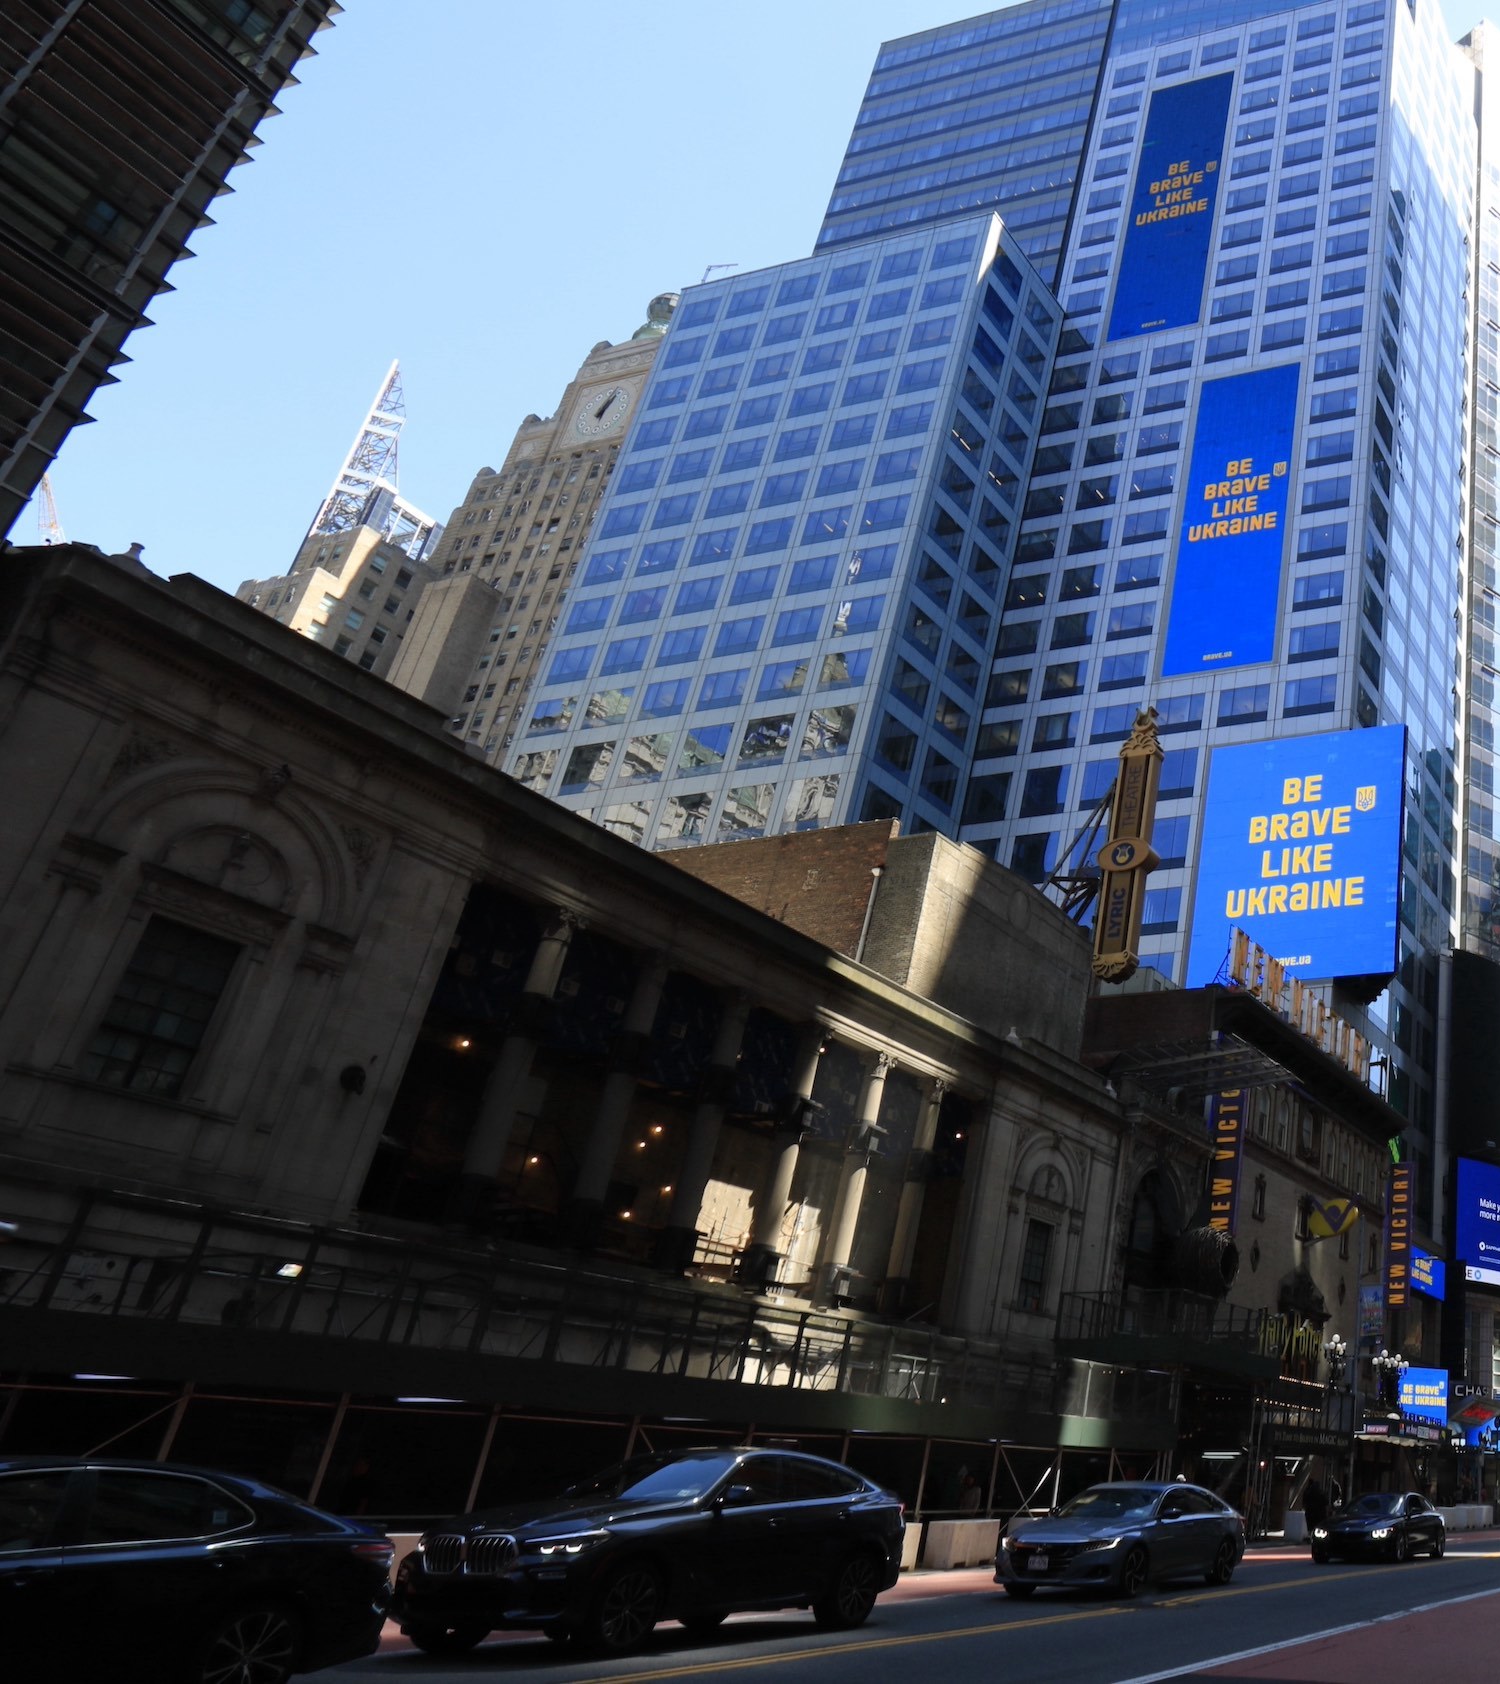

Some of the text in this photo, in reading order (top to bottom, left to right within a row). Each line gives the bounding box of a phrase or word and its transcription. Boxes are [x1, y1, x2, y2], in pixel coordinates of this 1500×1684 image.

[1168, 160, 1190, 176] BE
[1155, 187, 1193, 207] LIKE
[1226, 458, 1253, 478] BE
[1211, 495, 1259, 519] LIKE
[1282, 774, 1324, 806] BE
[1107, 763, 1143, 939] LYRIC THEATRE
[1260, 843, 1334, 879] LIKE
[1209, 1088, 1241, 1232] NEW VICTO
[1479, 1197, 1496, 1211] Make
[1479, 1210, 1497, 1221] more
[1388, 1167, 1410, 1306] NEW VICTORY
[1403, 1383, 1414, 1394] BE
[1455, 1384, 1489, 1397] CHAS
